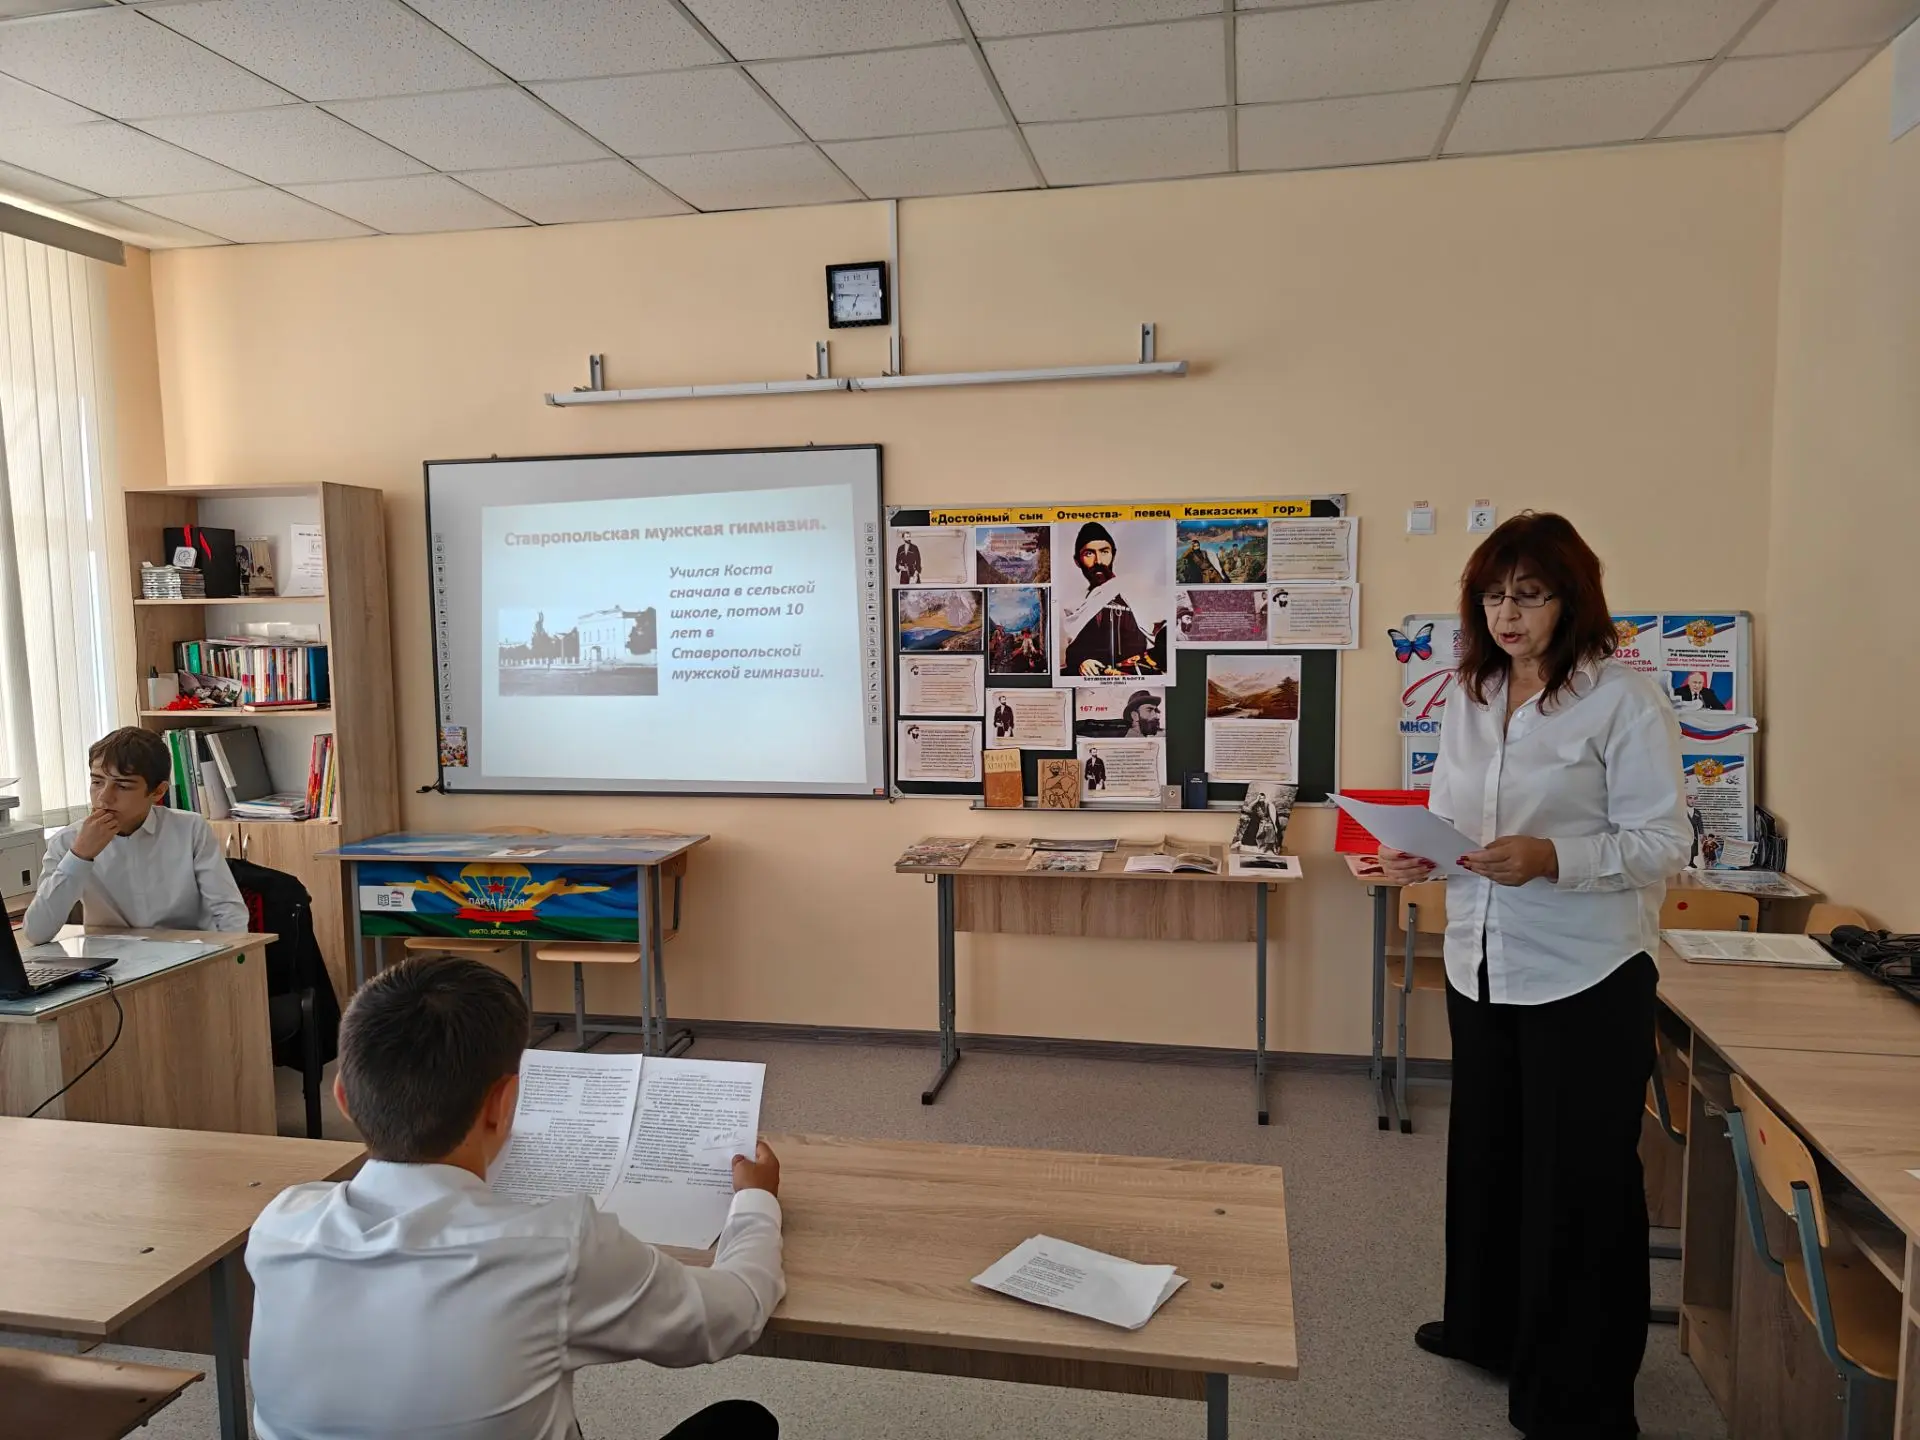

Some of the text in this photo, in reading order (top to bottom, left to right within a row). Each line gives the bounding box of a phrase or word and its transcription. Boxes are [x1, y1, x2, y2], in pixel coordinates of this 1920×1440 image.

[931, 513, 1010, 526] «Достойный
[1019, 512, 1043, 521] сын
[1134, 510, 1171, 518] певец
[1184, 507, 1259, 517] Кавказских
[1272, 505, 1303, 515] гор»
[504, 517, 827, 547] Ставропольская мужская гимназия.
[669, 563, 773, 579] Учился Коста
[669, 580, 816, 598] сначала в сельской
[670, 602, 804, 621] школе, потом 10
[670, 627, 714, 639] лет в
[671, 643, 802, 661] Ставропольской
[1614, 649, 1640, 658] 026
[671, 663, 824, 682] мужской гимназии.
[1400, 721, 1442, 732] МНОГ
